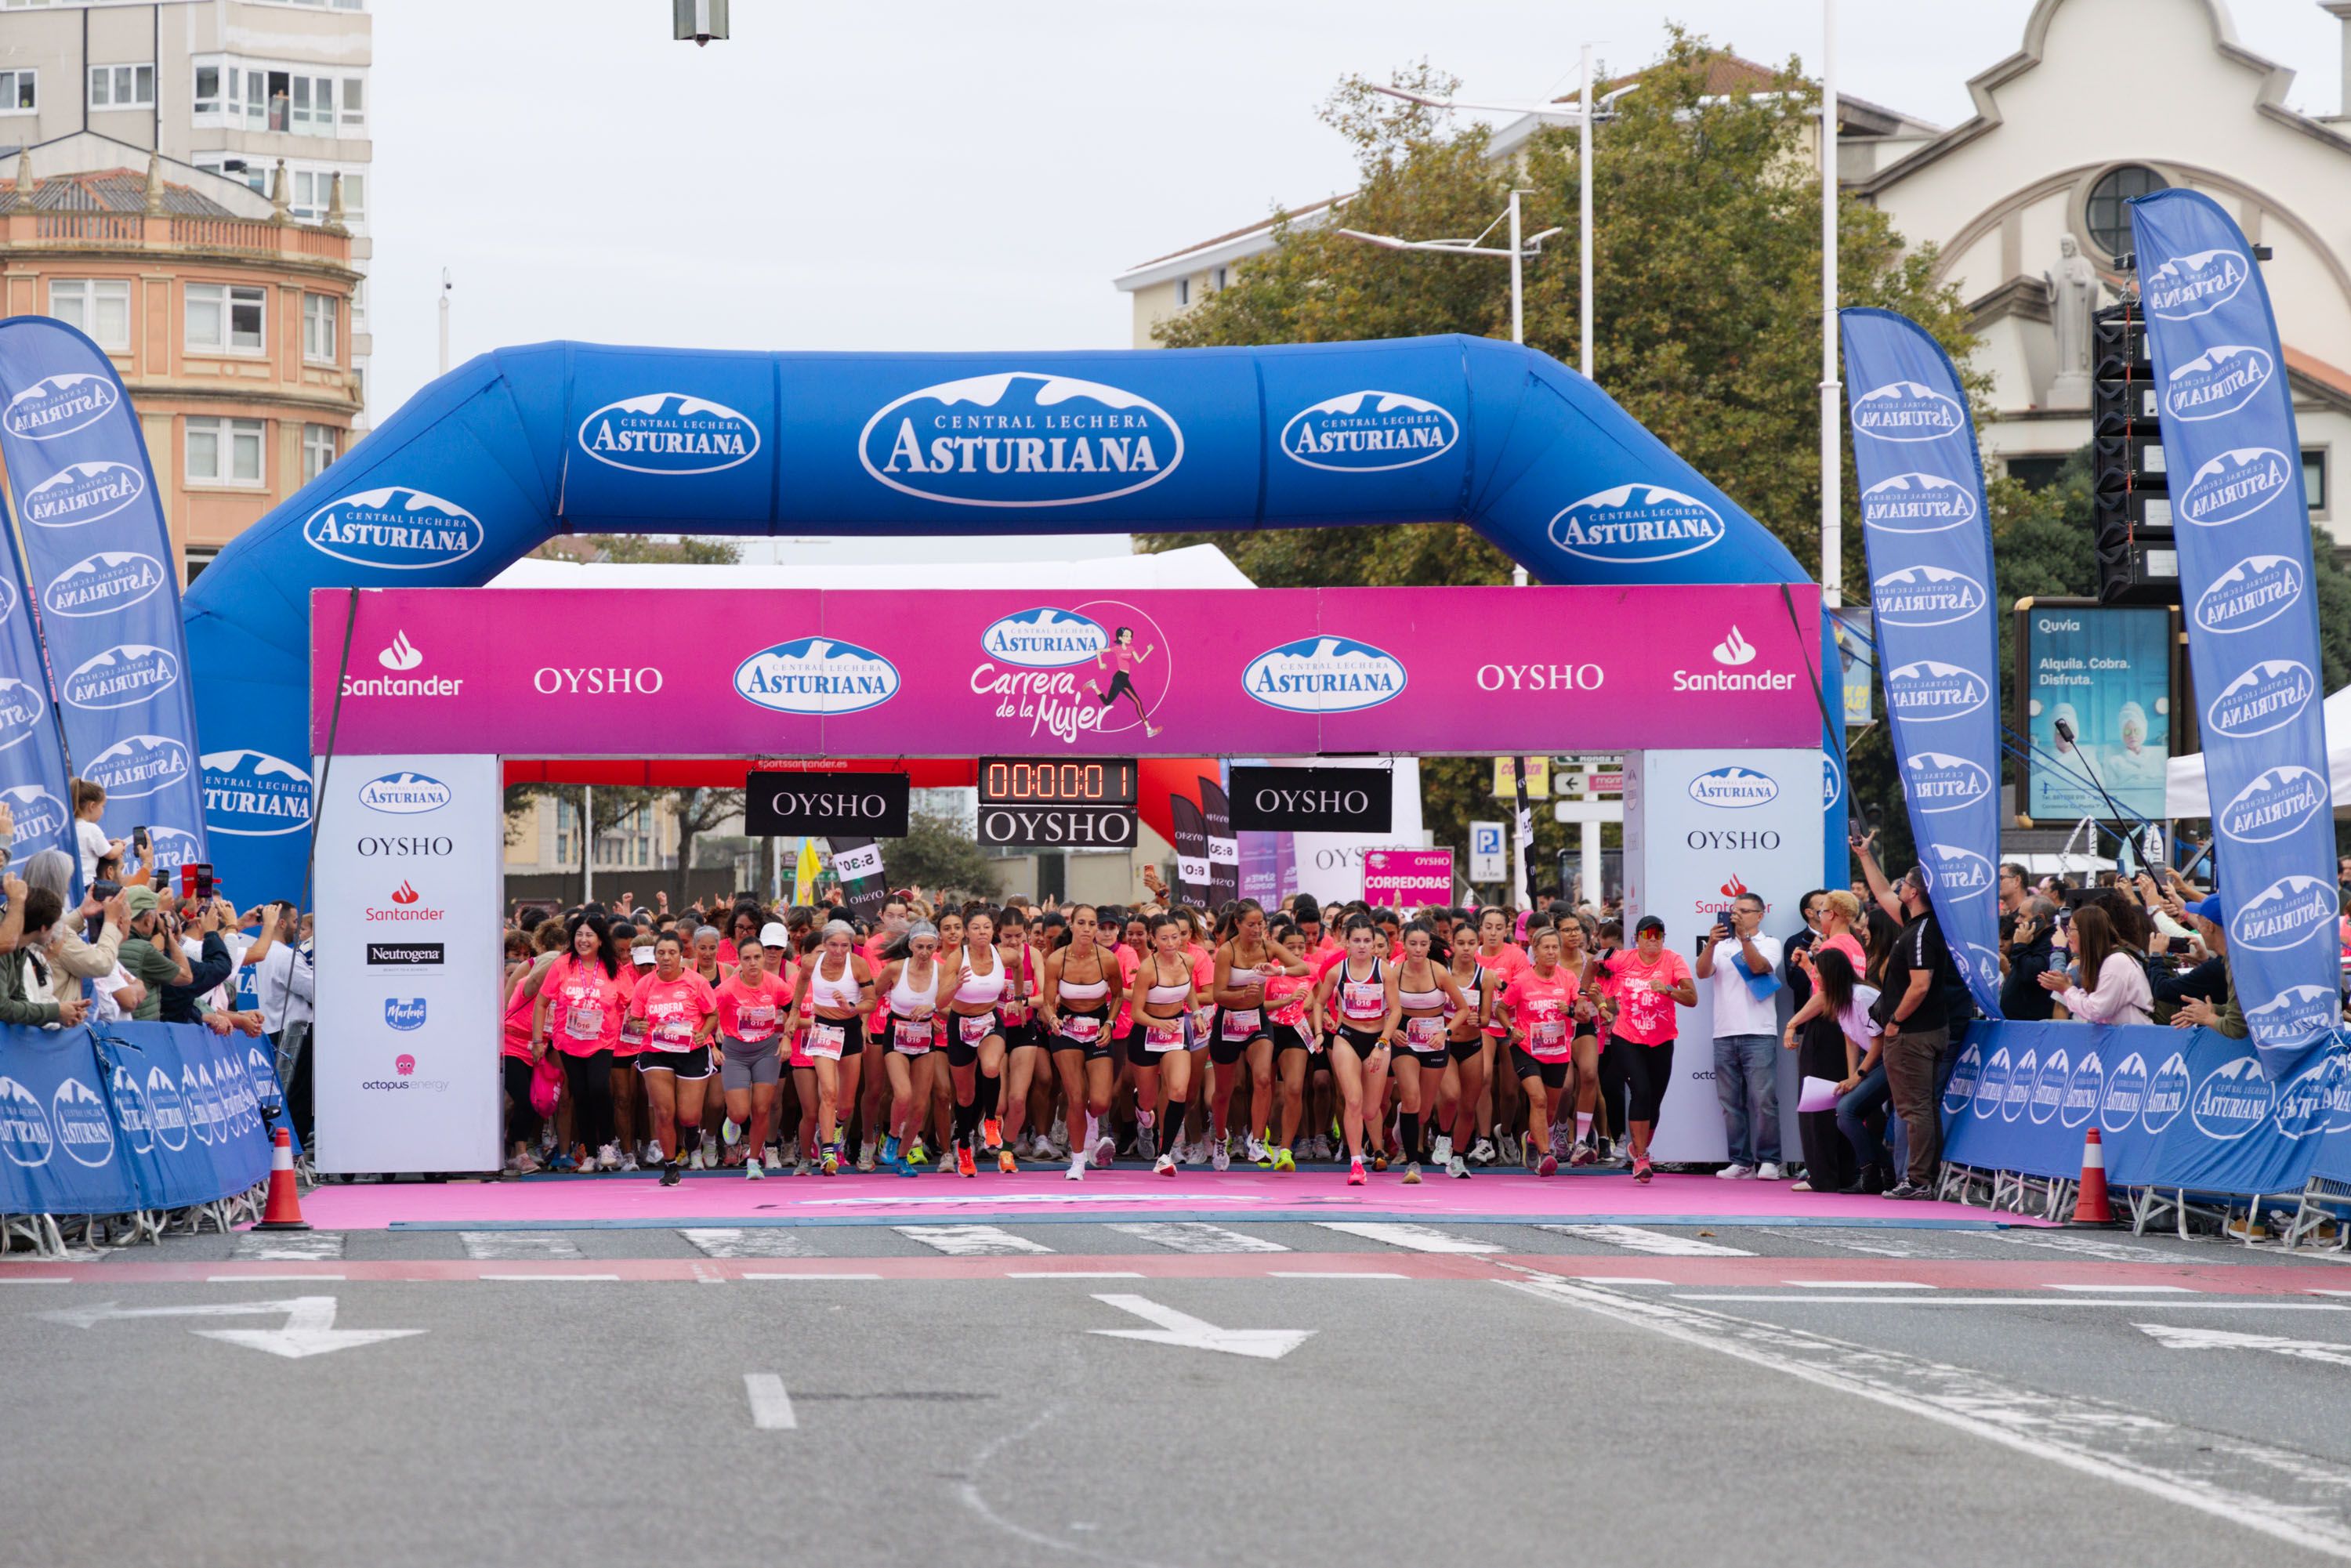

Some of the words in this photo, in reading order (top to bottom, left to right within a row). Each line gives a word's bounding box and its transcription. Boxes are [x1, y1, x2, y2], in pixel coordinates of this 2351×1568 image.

[621, 418, 679, 429] CENTRAL
[683, 419, 741, 430] LECHERA
[933, 415, 1036, 429] CENTRAL
[1046, 415, 1148, 429] LECHERA
[1321, 417, 1379, 429] CENTRAL
[1382, 413, 1440, 425] LECHERA
[592, 418, 747, 454] ASTURIANA
[882, 417, 1160, 473] ASTURIANA
[1295, 422, 1447, 454] ASTURIANA
[346, 511, 404, 523] CENTRAL
[410, 515, 468, 528] LECHERA
[1589, 509, 1646, 522] CENTRAL
[1651, 508, 1705, 517] LECHERA
[315, 512, 469, 551] ASTURIANA
[1563, 516, 1716, 545] ASTURIANA
[2038, 618, 2080, 634] Quvia
[992, 629, 1098, 652] ASTURIANA
[1280, 662, 1332, 671] CENTRAL
[1336, 661, 1389, 670] LECHERA
[2039, 658, 2087, 672] Alquila.
[2089, 657, 2131, 670] Cobra.
[341, 675, 463, 697] Santander
[534, 668, 663, 693] OYSHO
[747, 665, 887, 694] ASTURIANA
[970, 662, 1075, 695] Carrera
[1255, 664, 1394, 692] ASTURIANA
[1477, 664, 1605, 690] OYSHO
[1673, 670, 1796, 691] Santander
[2039, 673, 2094, 686] Disfruta.
[995, 695, 1016, 718] de
[1020, 695, 1034, 718] la
[1030, 691, 1114, 744] Mujer
[205, 776, 252, 788] ENTRAL
[258, 780, 309, 793] LECHERA
[1696, 782, 1772, 798] ASTURIANA
[203, 787, 310, 819] TURIANA
[366, 788, 444, 803] ASTURIANA
[773, 791, 886, 818] OYSHO
[1255, 789, 1368, 814] OYSHO
[985, 811, 1130, 843] OYSHO
[358, 837, 453, 856] OYSHO
[1480, 831, 1494, 853] P
[1687, 831, 1780, 849] OYSHO
[1414, 856, 1450, 866] OYSHO
[1365, 876, 1451, 889] CORREDORAS
[366, 907, 444, 921] Santander
[371, 947, 439, 963] Neutrogena
[386, 1005, 424, 1023] Marlene
[649, 1002, 684, 1014] CARRERA
[664, 1030, 679, 1041] 016
[362, 1080, 408, 1092] octopus
[410, 1081, 450, 1092] energy
[2103, 1081, 2141, 1113] ASTURIANA
[2195, 1085, 2267, 1120] ASTURIANA
